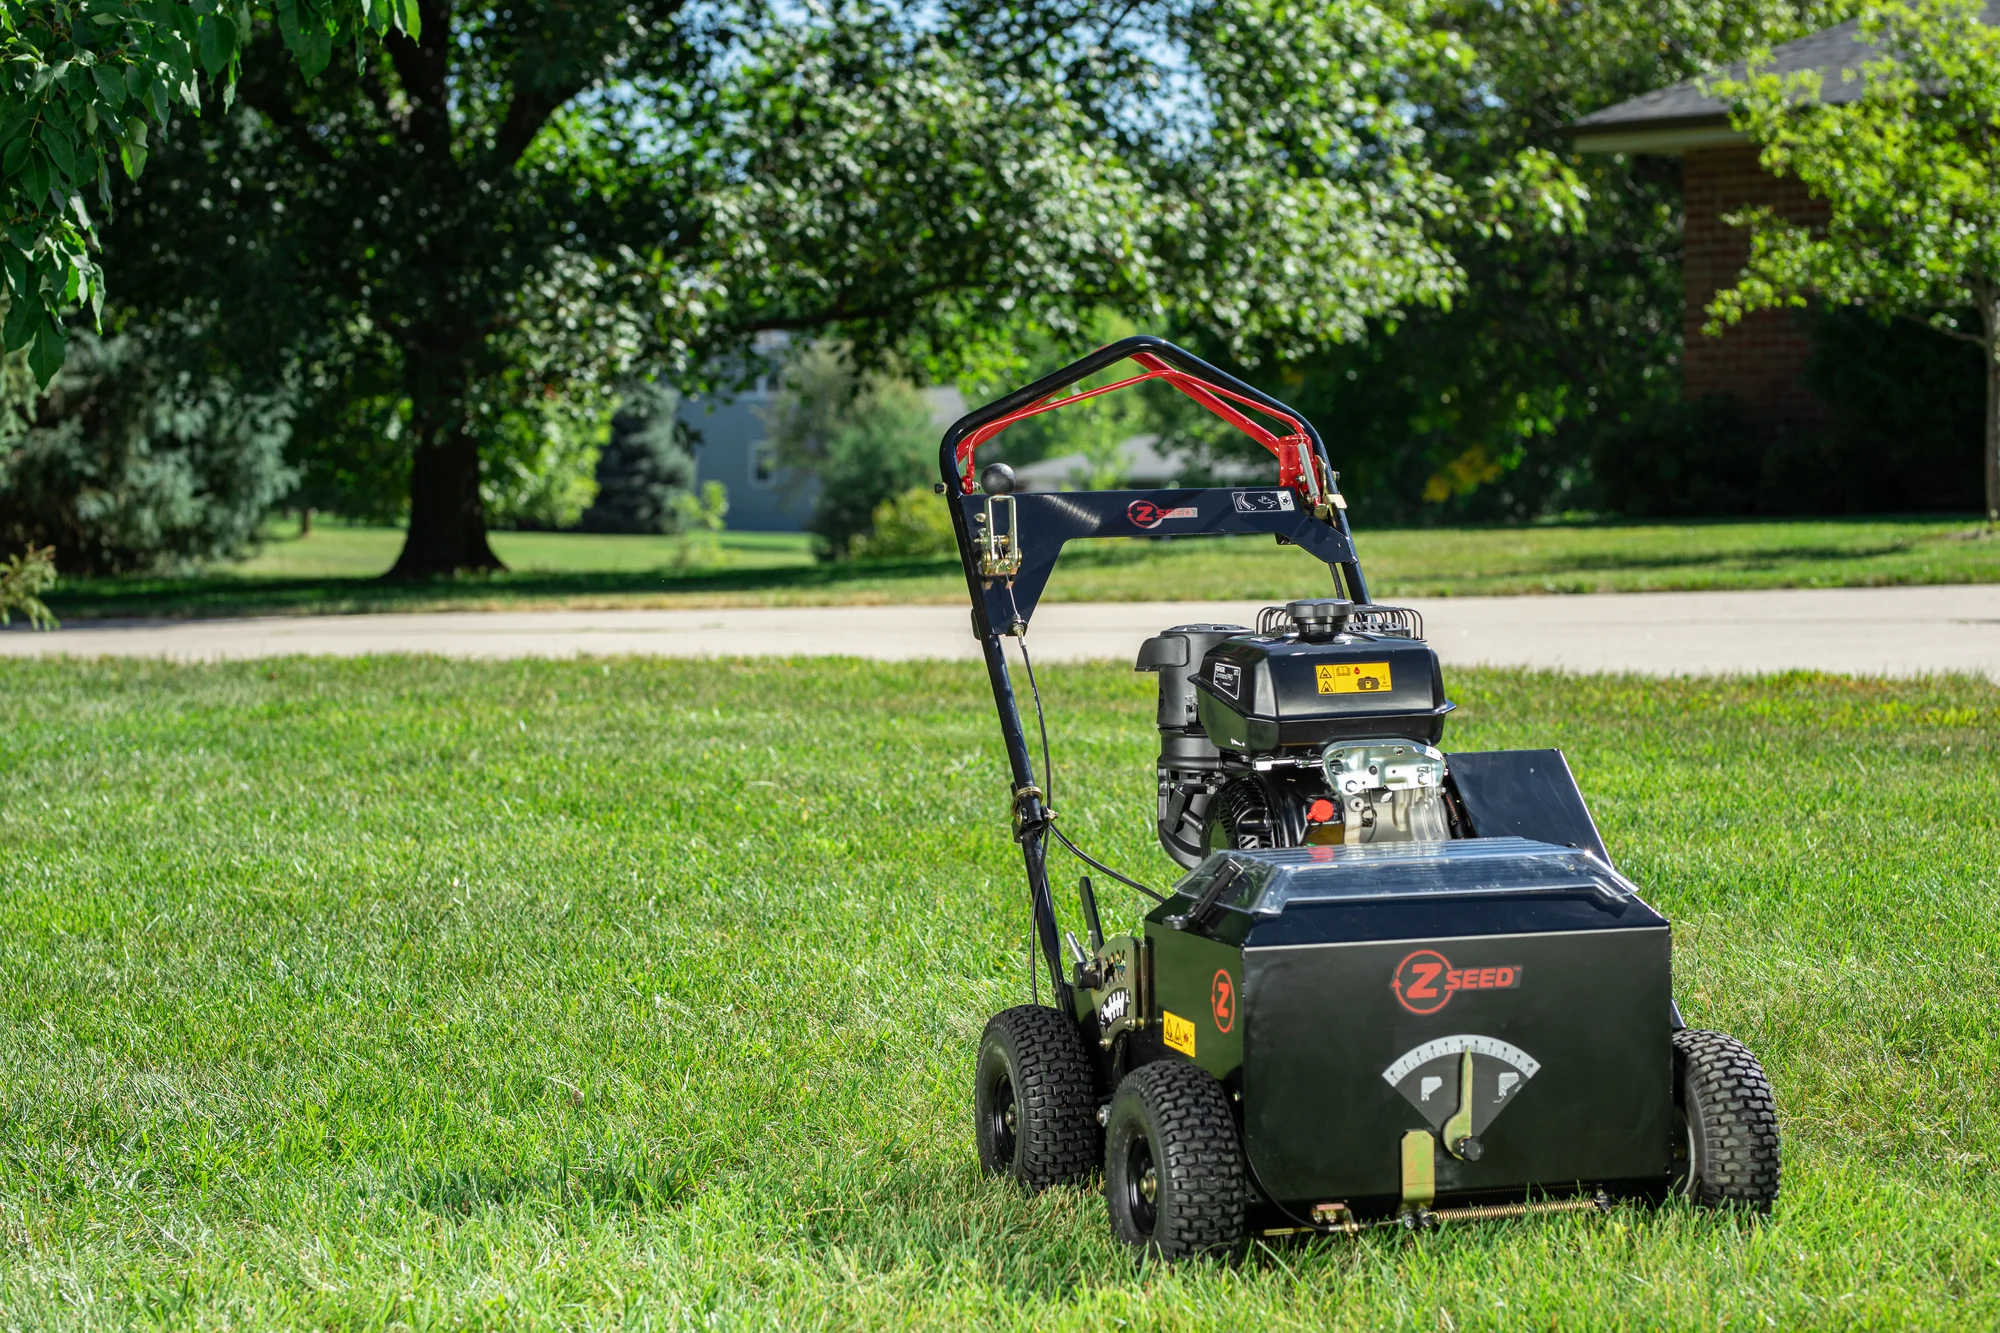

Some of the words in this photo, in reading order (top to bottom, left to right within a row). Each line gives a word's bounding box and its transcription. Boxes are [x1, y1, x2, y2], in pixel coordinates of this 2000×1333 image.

[1136, 506, 1153, 521] Z
[1406, 963, 1442, 999] Z
[1217, 982, 1229, 1018] Z
